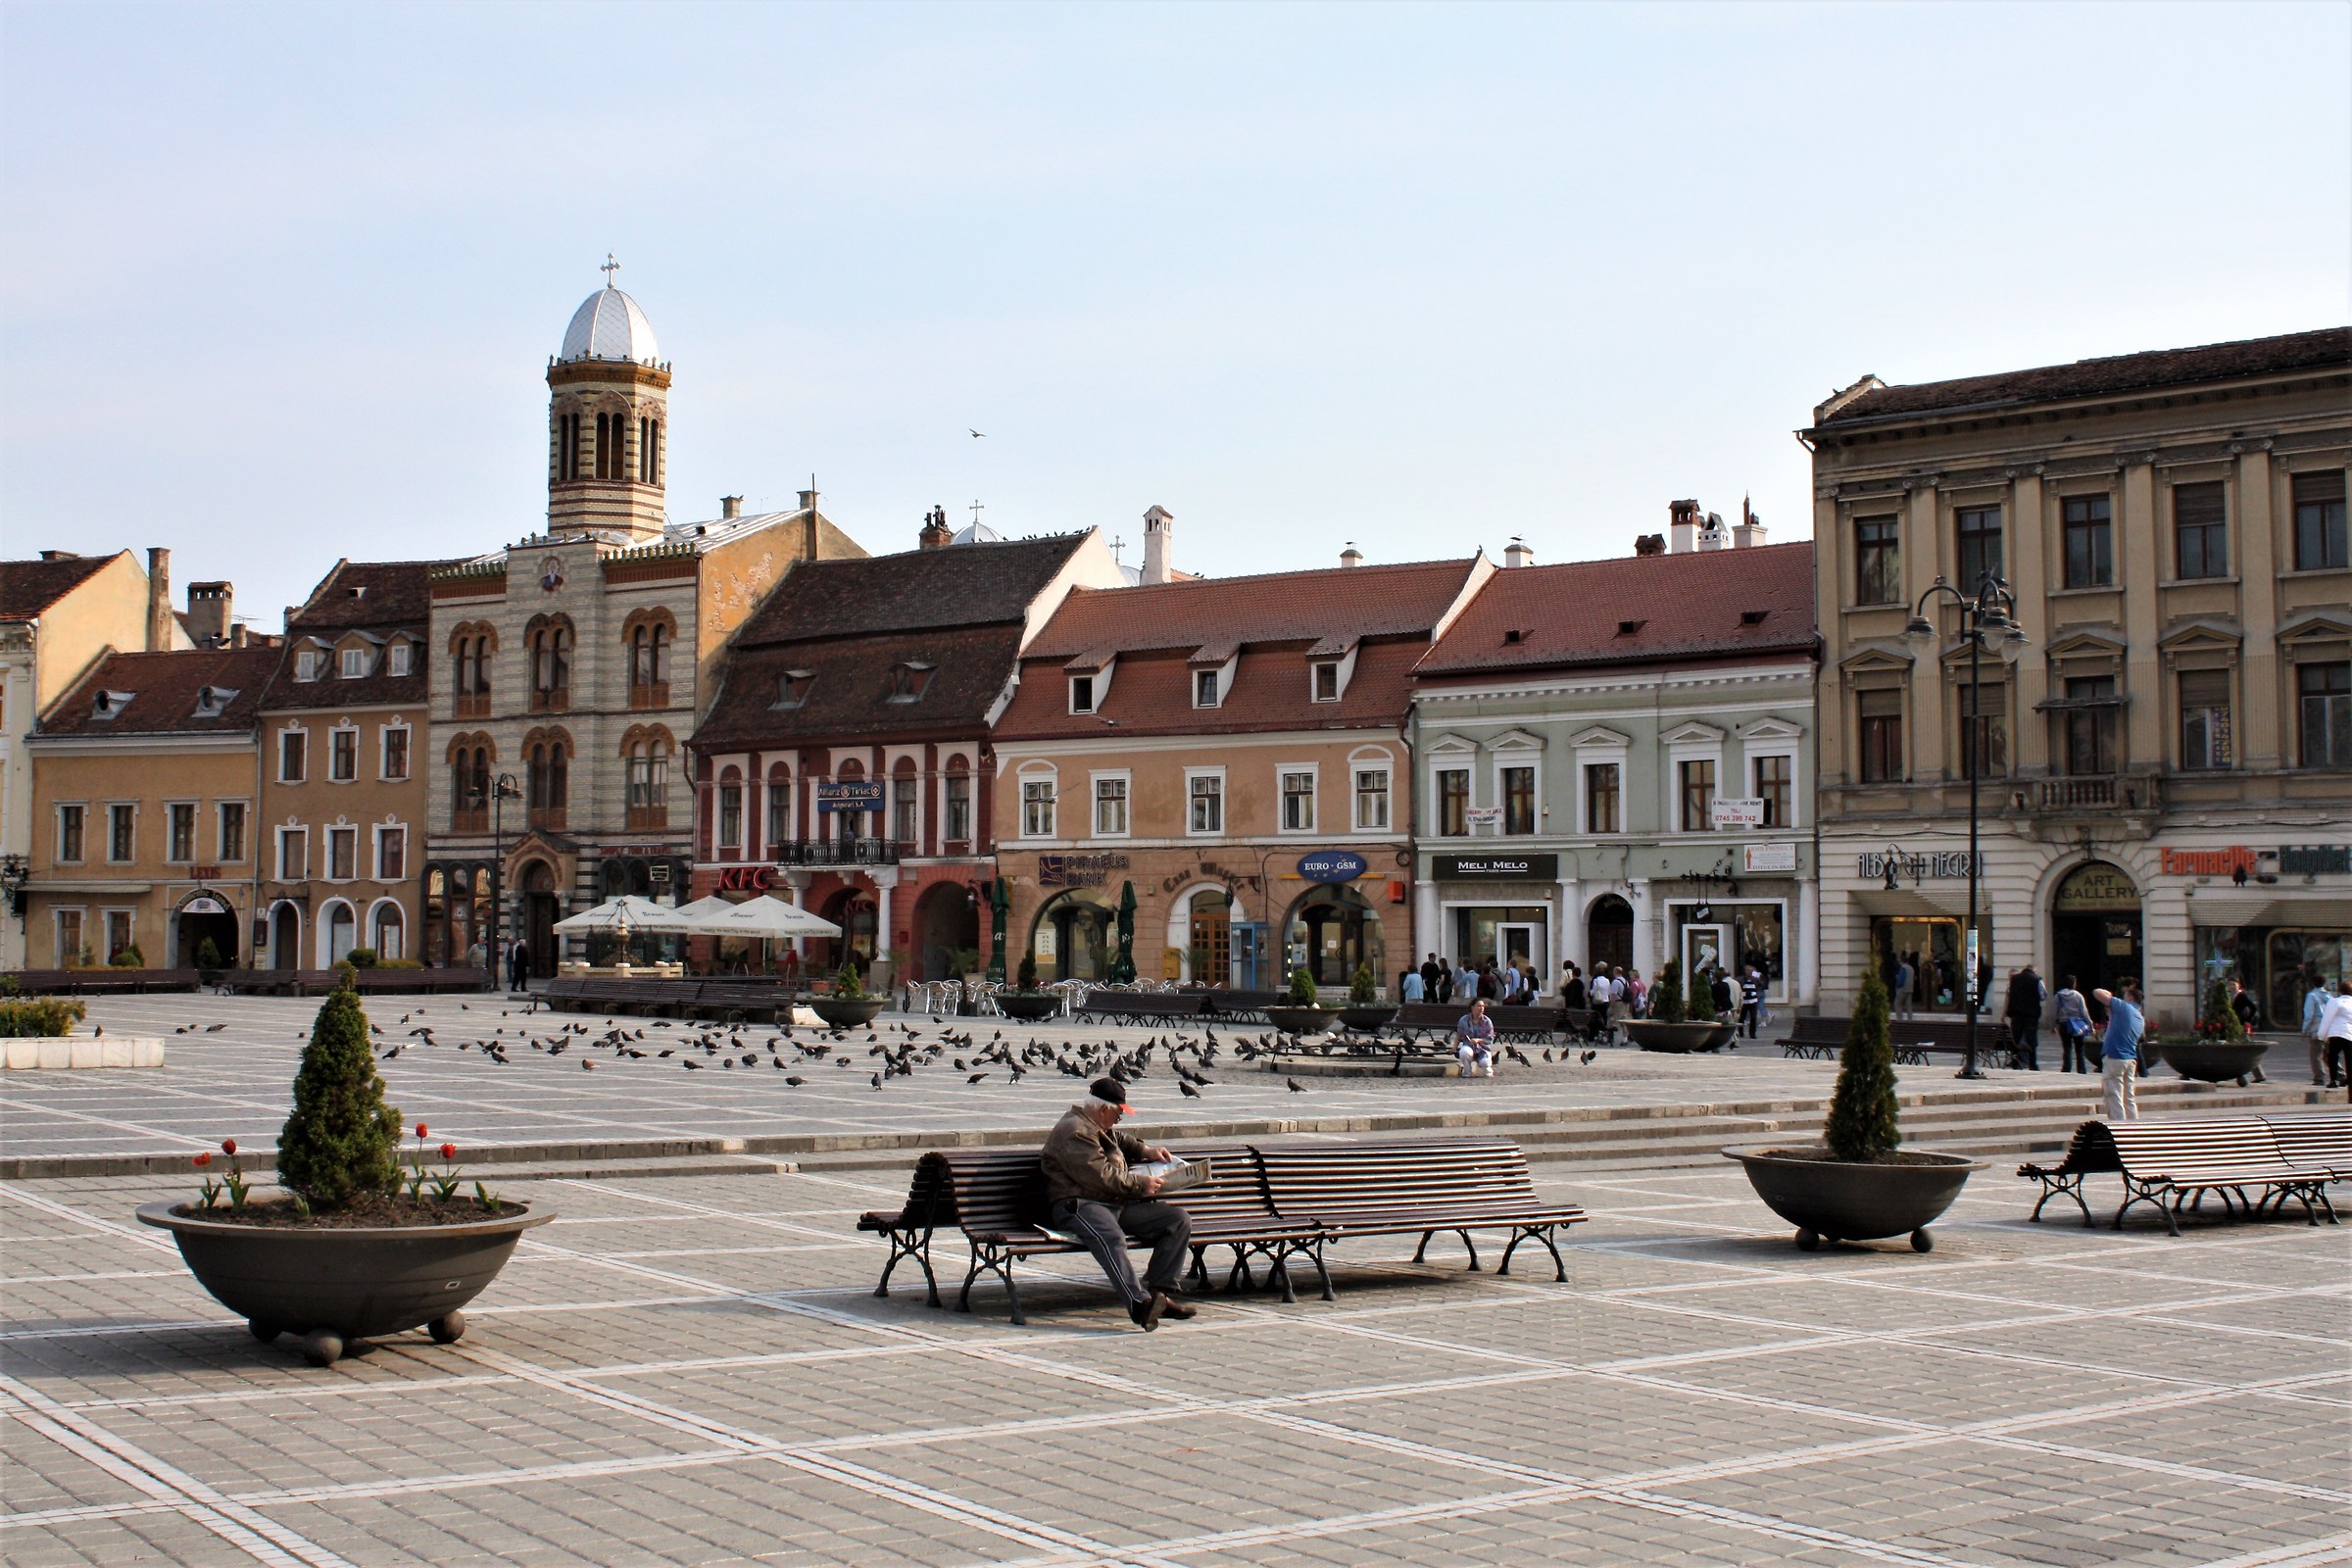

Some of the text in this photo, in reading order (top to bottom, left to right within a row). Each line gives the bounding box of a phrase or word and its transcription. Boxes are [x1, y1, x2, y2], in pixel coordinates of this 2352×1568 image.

[818, 788, 841, 797] Allianz
[1066, 855, 1128, 869] PIRAEUS
[1304, 861, 1356, 871] EURO GSM
[189, 866, 220, 879] LEXIS
[717, 866, 773, 890] KFC
[1066, 872, 1105, 885] BANK
[2083, 875, 2114, 887] ART
[2061, 887, 2137, 900] GALLERY
[845, 900, 872, 912] KFC
